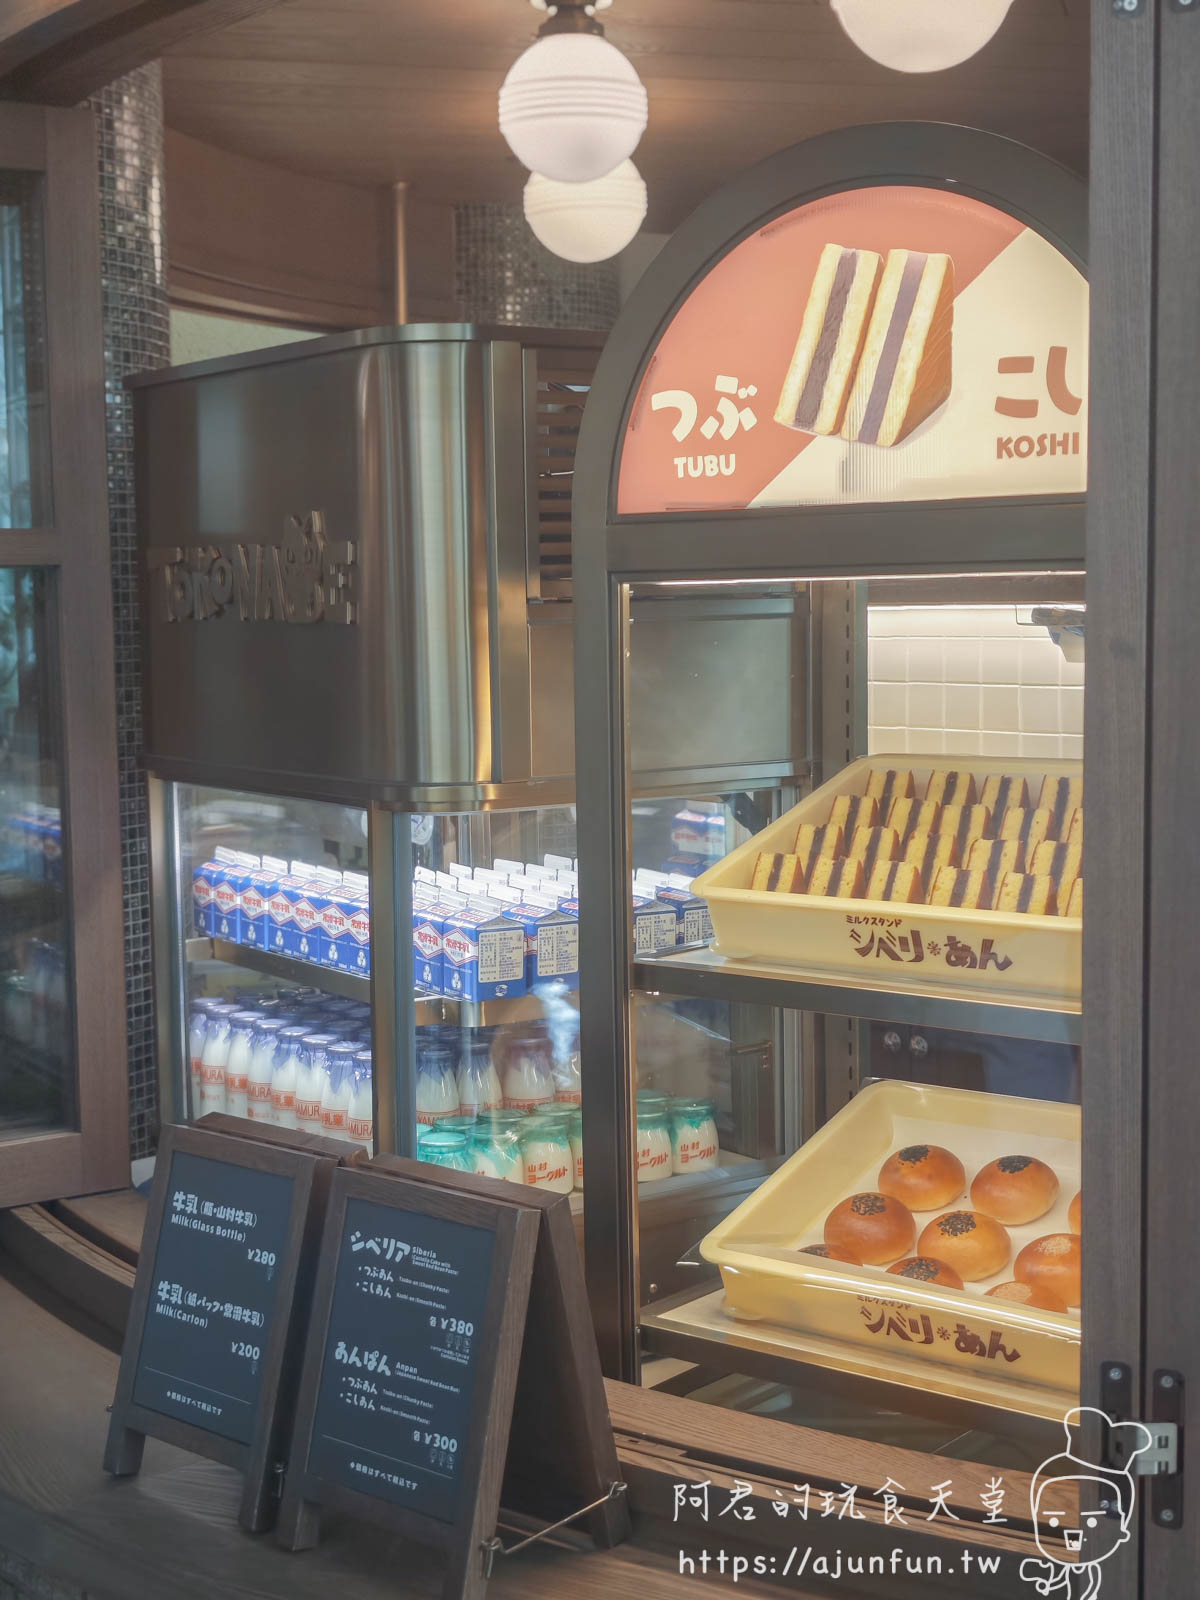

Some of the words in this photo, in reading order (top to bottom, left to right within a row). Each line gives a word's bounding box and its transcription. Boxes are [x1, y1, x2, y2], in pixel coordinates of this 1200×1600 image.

[994, 346, 1083, 418] こし
[652, 375, 758, 442] つぶ
[996, 432, 1080, 459] KOSHI
[673, 453, 737, 479] TUBU
[846, 914, 902, 928] ミルクスタンド
[849, 928, 925, 963] シベリ
[943, 935, 1013, 971] あん
[528, 1162, 548, 1173] 山村
[247, 1248, 276, 1266] ¥280
[350, 1230, 411, 1262] シベリア
[441, 1318, 474, 1336] ¥380
[860, 1305, 934, 1345] シベリ
[954, 1323, 1021, 1363] あん
[231, 1341, 260, 1360] ¥200
[335, 1341, 391, 1376] あんぱん
[396, 1362, 418, 1374] Anpan
[425, 1432, 458, 1453] ¥300
